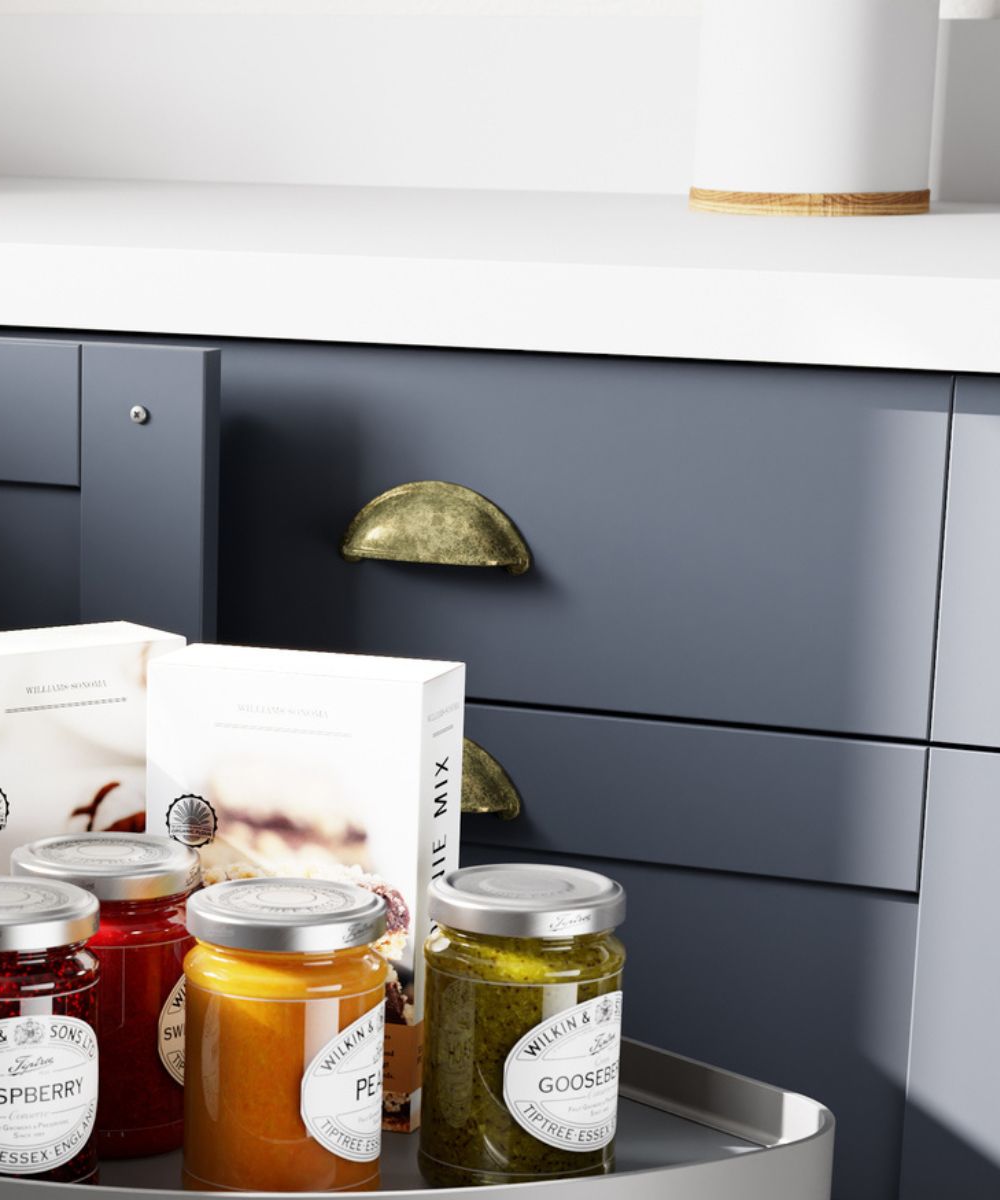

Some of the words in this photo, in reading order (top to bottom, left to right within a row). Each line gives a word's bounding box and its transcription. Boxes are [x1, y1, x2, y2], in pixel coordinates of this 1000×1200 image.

[434, 756, 449, 818] MIX
[50, 1025, 83, 1045] SONS
[320, 1029, 365, 1070] WILKIN
[524, 1016, 577, 1056] WILKIN
[581, 1011, 590, 1024] &
[321, 1120, 361, 1151] TIPTREE
[523, 1104, 572, 1141] TIPTREE
